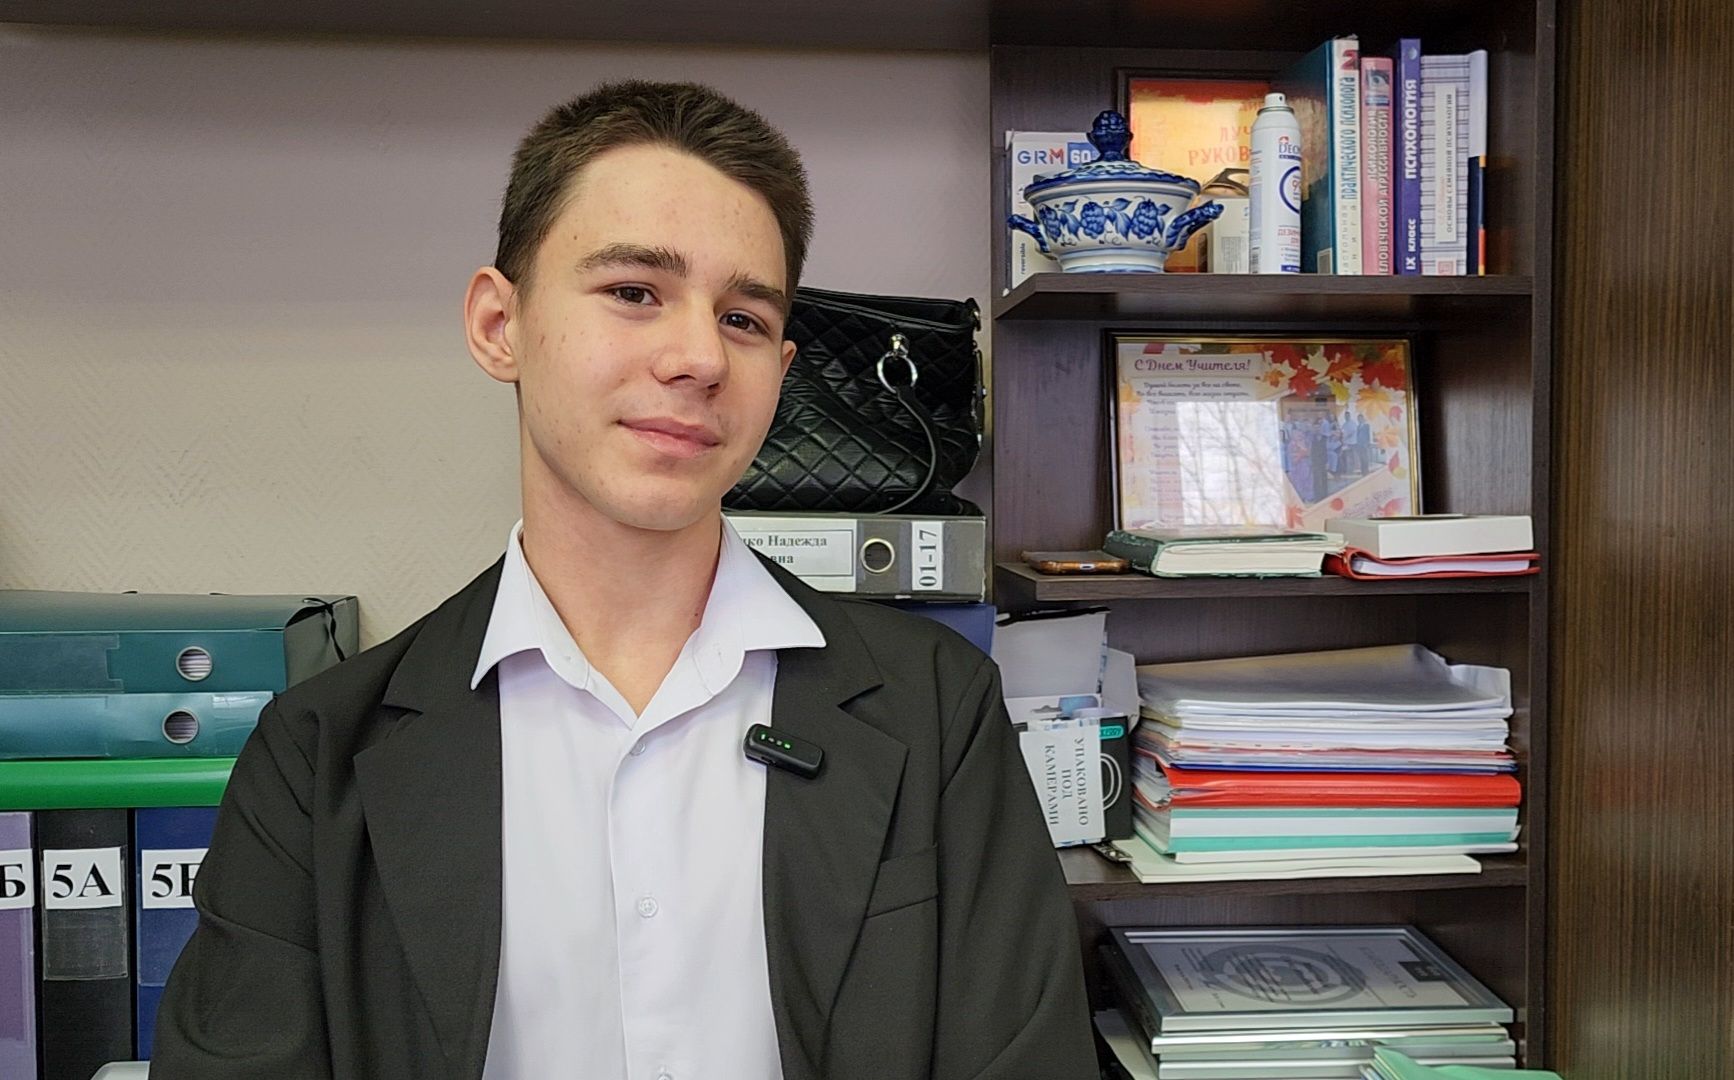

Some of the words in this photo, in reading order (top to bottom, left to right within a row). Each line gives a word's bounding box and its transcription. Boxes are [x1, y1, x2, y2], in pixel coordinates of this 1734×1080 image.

[1342, 49, 1358, 70] 2
[1367, 110, 1377, 181] ПСИХОЛОГИЯ
[1405, 79, 1417, 179] ПСИХОЛОГИЯ
[1017, 148, 1064, 165] GRM
[1070, 150, 1091, 164] 60
[1378, 110, 1389, 196] АГРЕССИВНОСТИ
[1407, 218, 1416, 252] класс
[1405, 256, 1416, 270] IX
[1145, 359, 1184, 371] Днем
[1186, 359, 1252, 371] Учителя!
[768, 535, 828, 547] Надежда
[919, 530, 937, 587] 01-17
[1045, 745, 1059, 825] КАМЕРАМИ
[1062, 769, 1072, 799] ПОД
[1074, 738, 1088, 825] УПАКОВАНО
[52, 862, 115, 899] 5А
